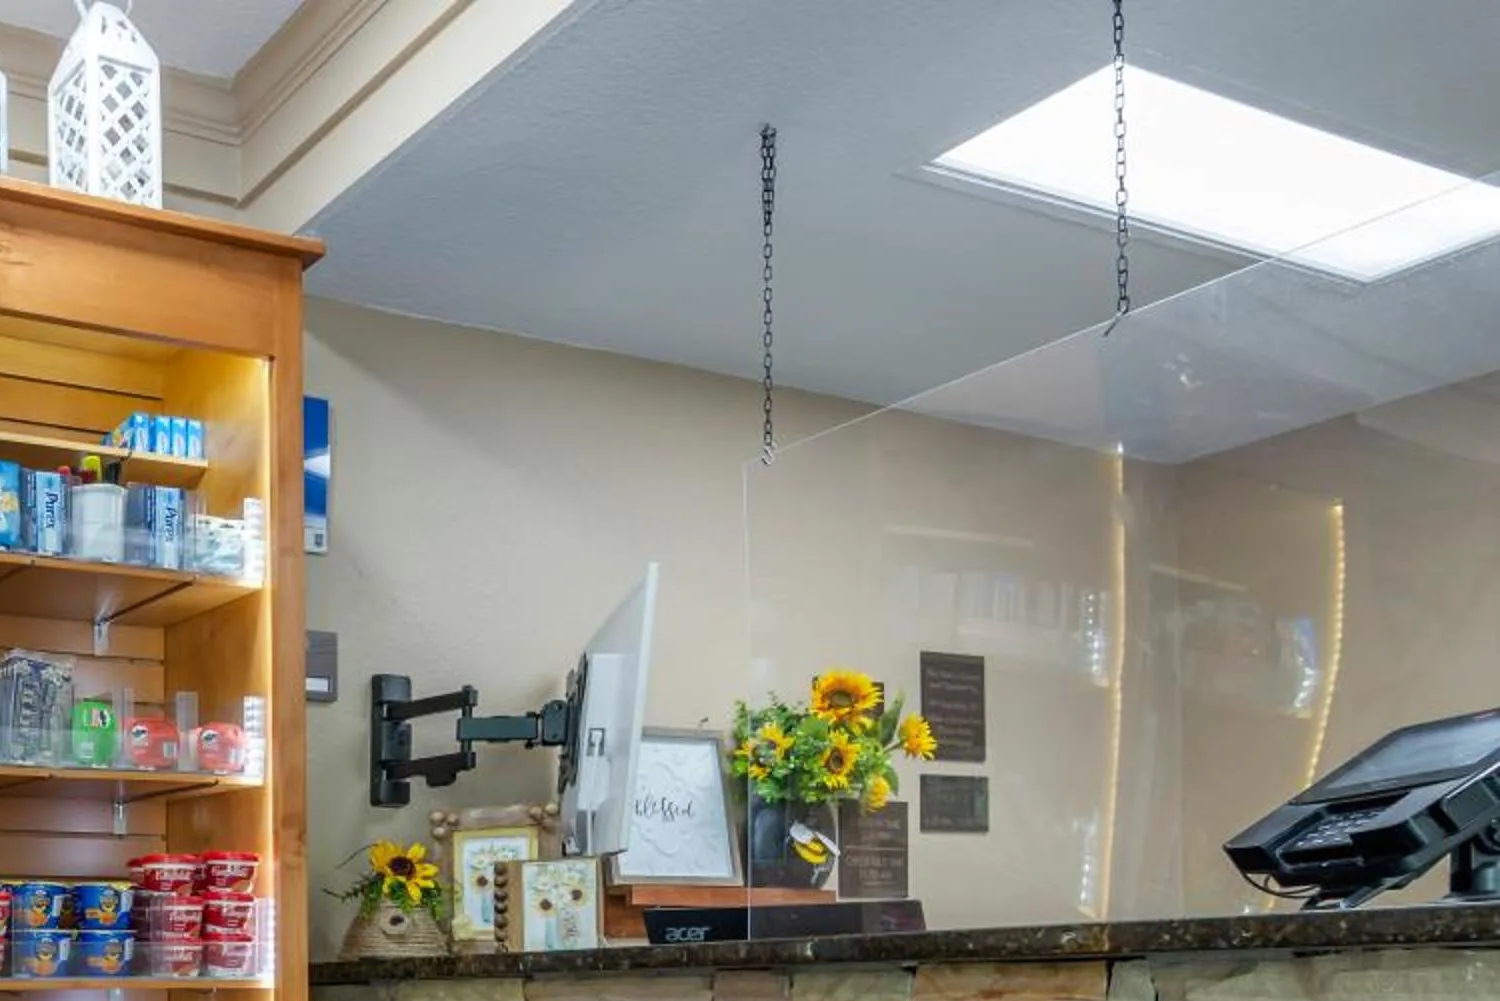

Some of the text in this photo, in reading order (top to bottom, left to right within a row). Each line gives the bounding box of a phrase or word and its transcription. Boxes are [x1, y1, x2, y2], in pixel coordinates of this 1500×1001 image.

[45, 491, 59, 528] Purex
[164, 506, 179, 542] Purex
[665, 926, 711, 943] acer
